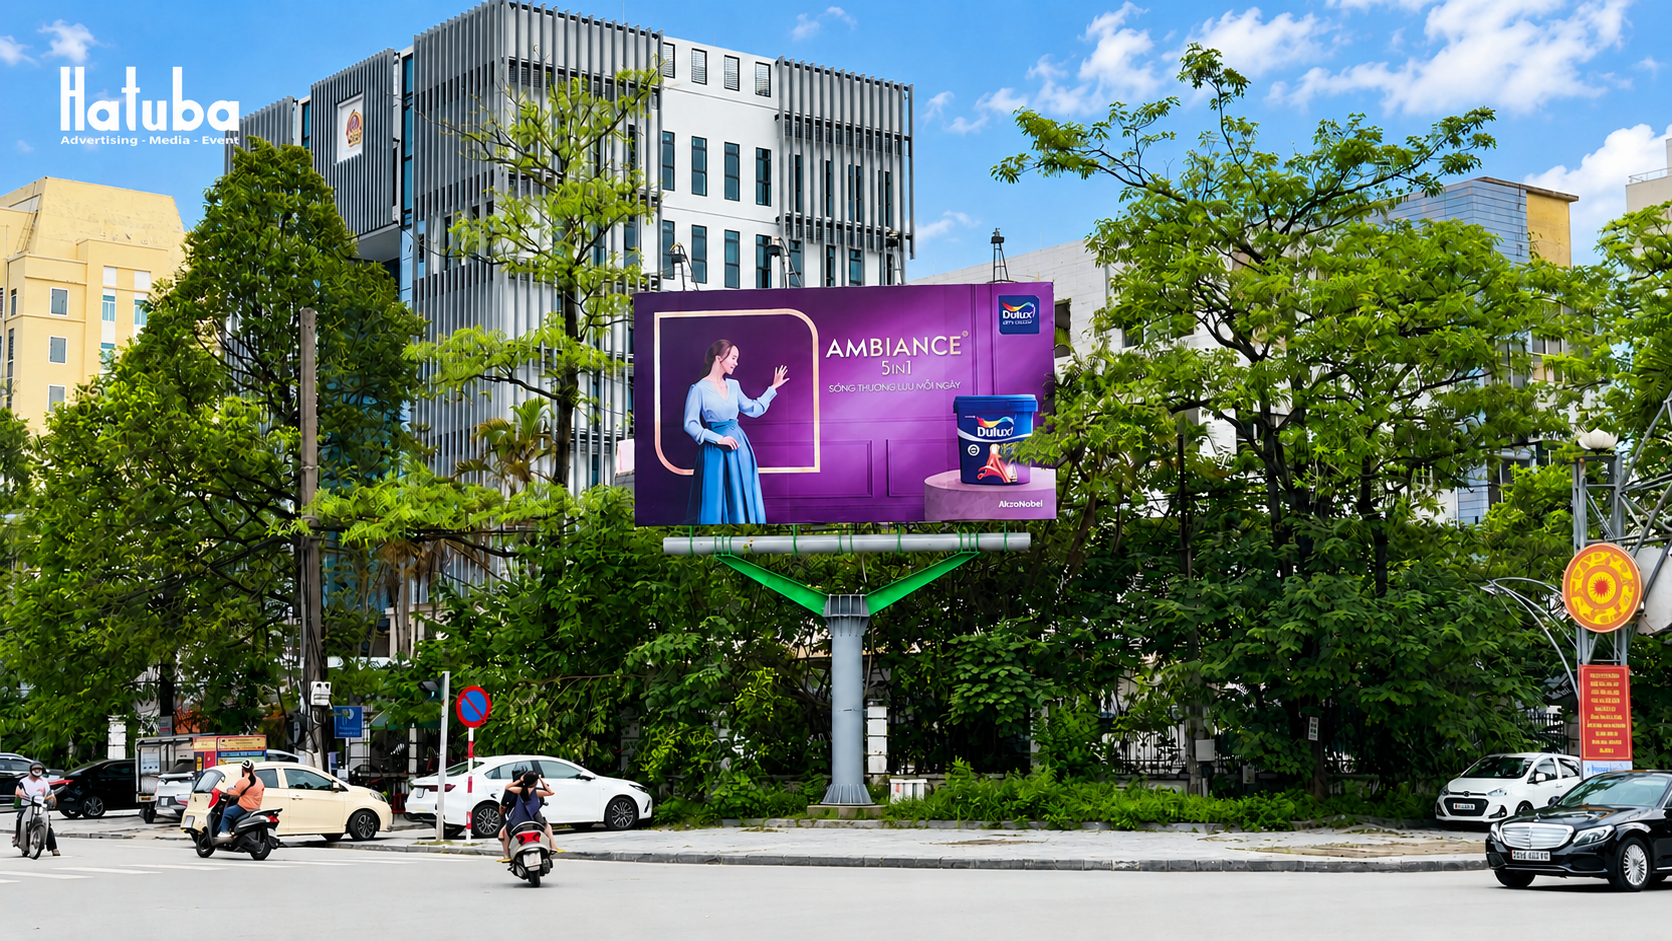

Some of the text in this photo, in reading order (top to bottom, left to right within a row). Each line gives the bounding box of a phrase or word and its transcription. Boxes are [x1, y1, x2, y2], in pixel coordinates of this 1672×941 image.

[1002, 310, 1032, 319] Dulux
[977, 426, 1012, 437] Dulux
[998, 500, 1043, 508] AkzoNobel
